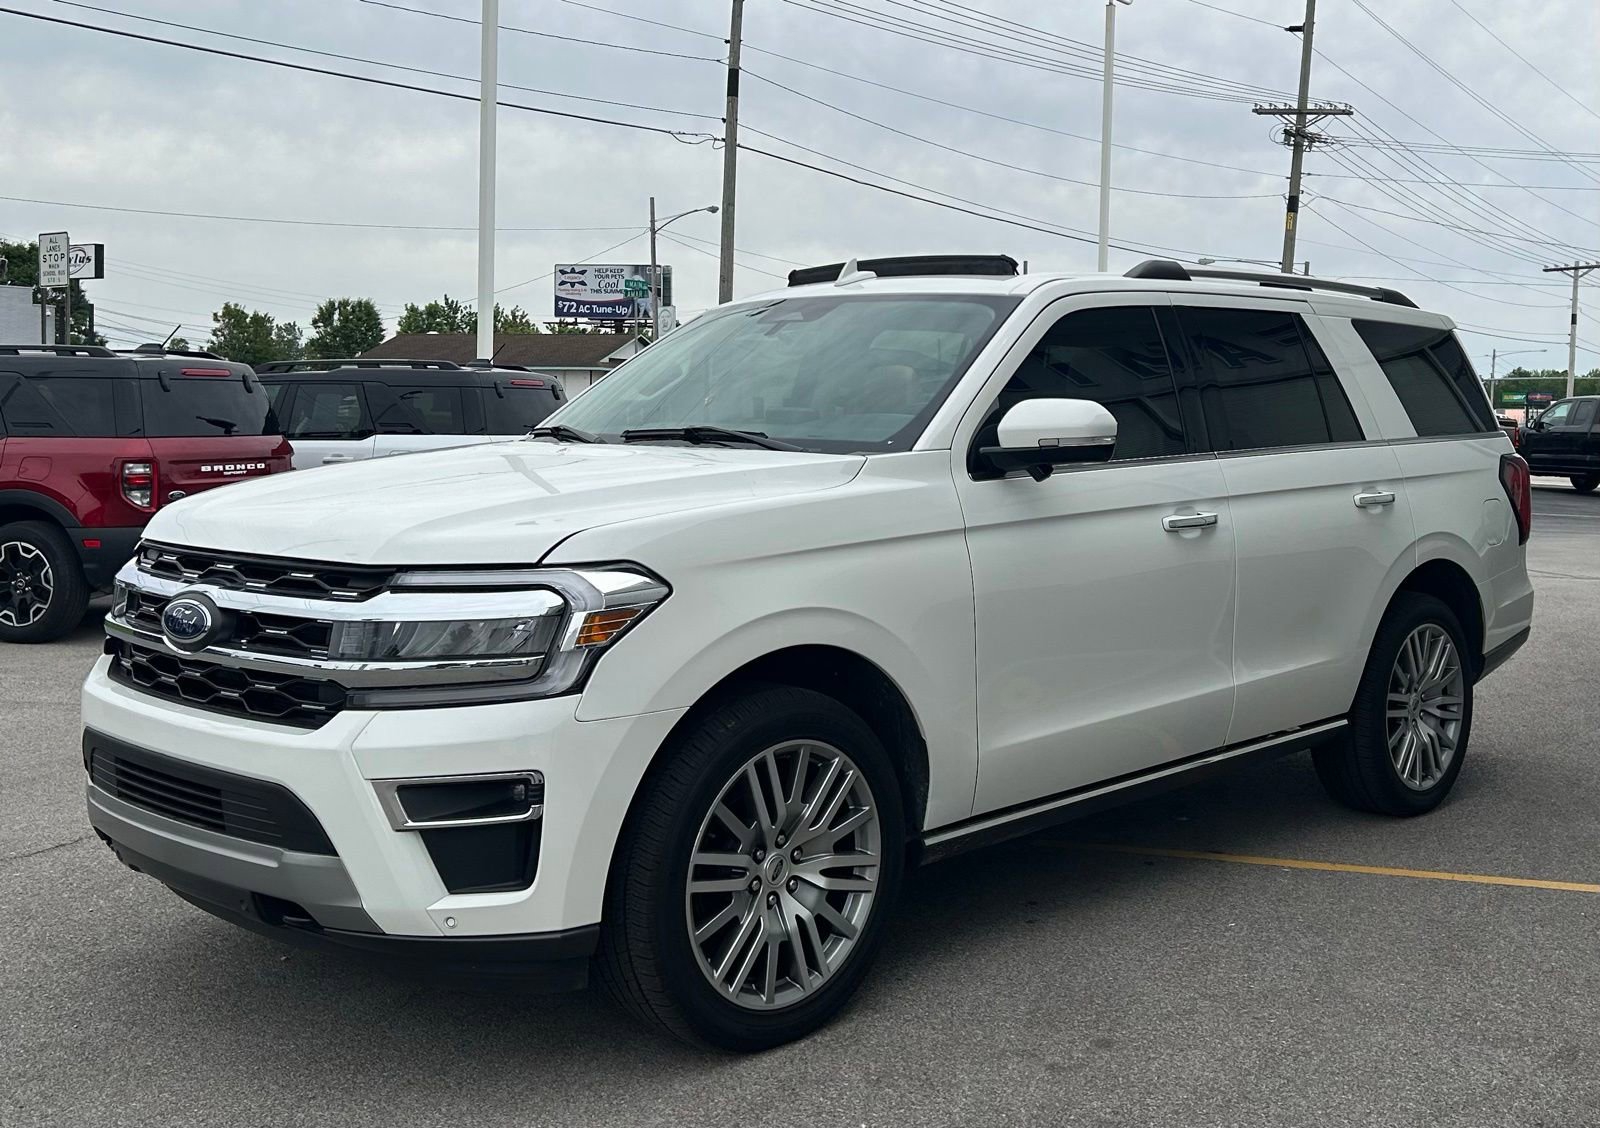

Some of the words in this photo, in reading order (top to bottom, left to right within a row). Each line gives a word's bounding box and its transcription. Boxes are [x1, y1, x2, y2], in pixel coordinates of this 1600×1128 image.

[49, 236, 58, 244] ALL
[46, 245, 61, 253] LANES
[42, 253, 66, 263] STOP
[598, 279, 619, 289] Cool
[557, 300, 577, 313] $72
[578, 304, 591, 313] AC
[591, 305, 628, 315] Tune-Up
[200, 463, 266, 472] BRONCO
[168, 607, 198, 633] Ford
